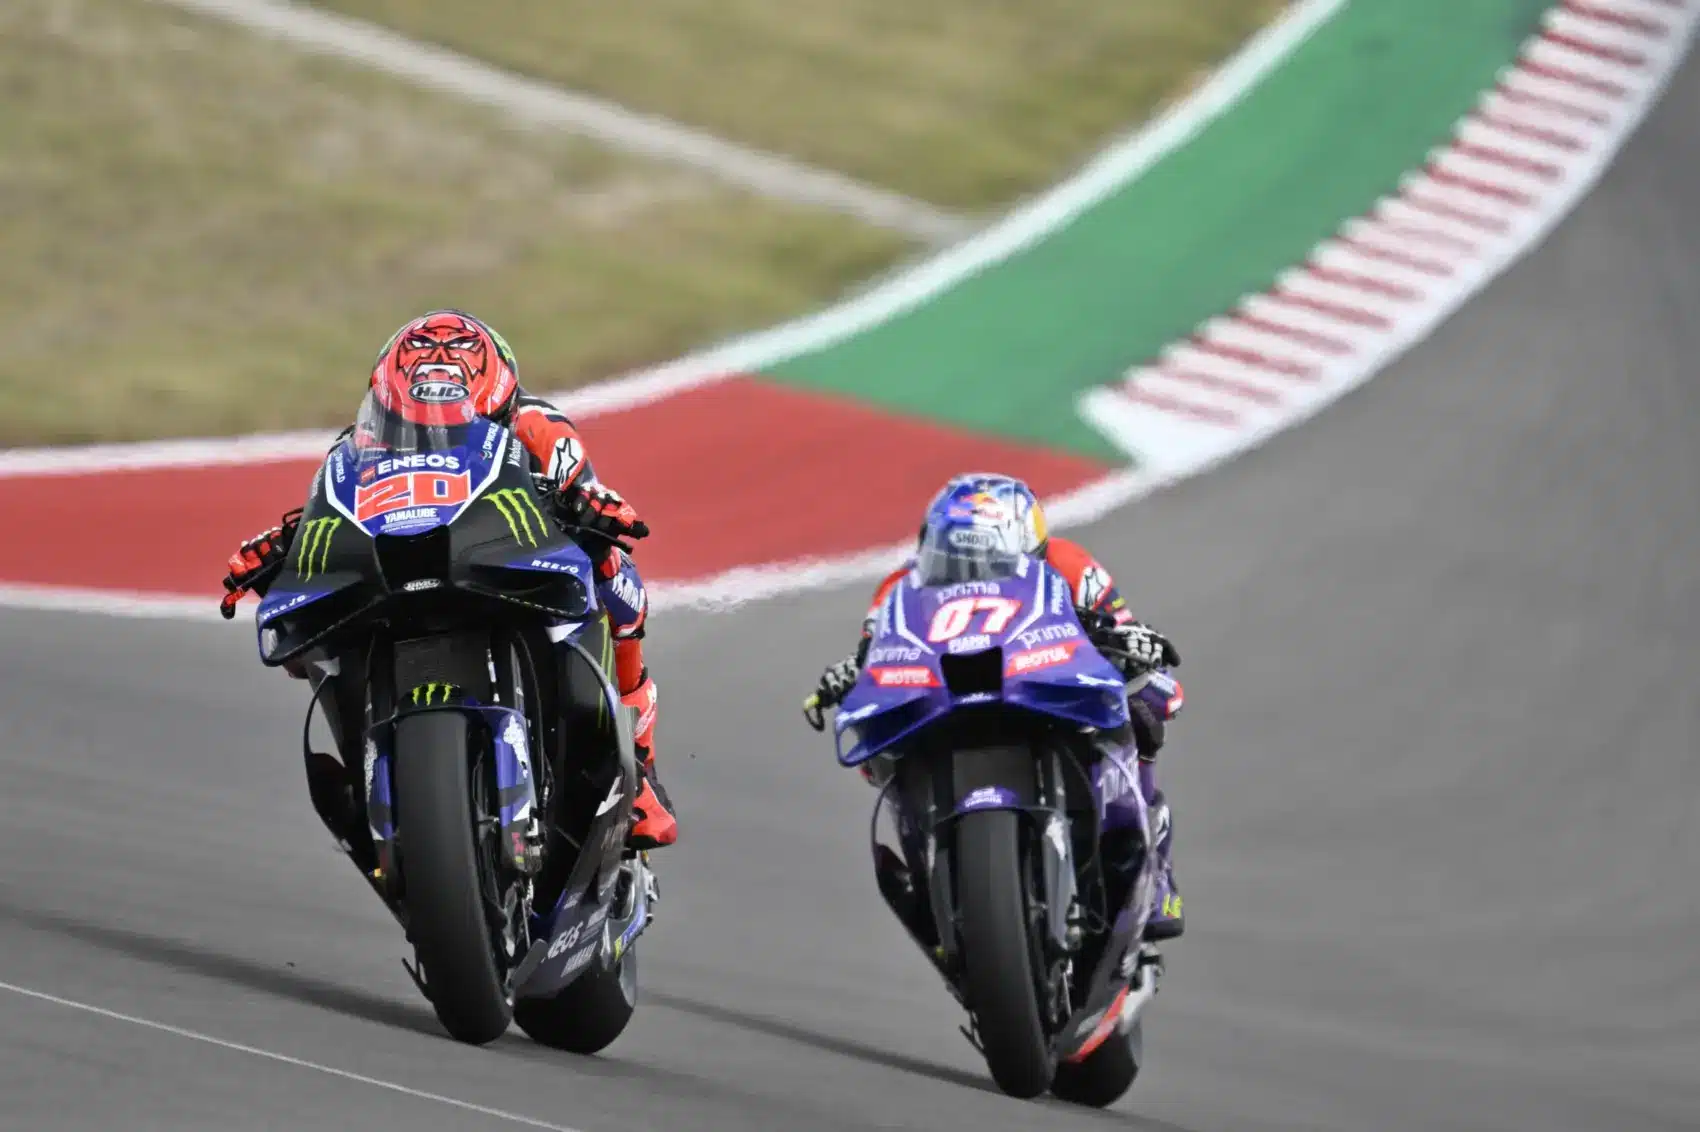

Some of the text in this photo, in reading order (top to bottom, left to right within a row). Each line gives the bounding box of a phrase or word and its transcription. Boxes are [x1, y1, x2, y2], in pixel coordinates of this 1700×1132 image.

[415, 386, 462, 398] HJC
[378, 454, 460, 475] ENEOS
[354, 469, 471, 524] 20
[384, 507, 438, 524] YAMALUBE
[531, 559, 580, 574] REEVO
[936, 581, 1001, 604] prima
[927, 597, 1022, 643] 07
[1017, 622, 1079, 650] prima
[1015, 645, 1070, 672] MOTUL
[880, 669, 932, 685] MOTUL
